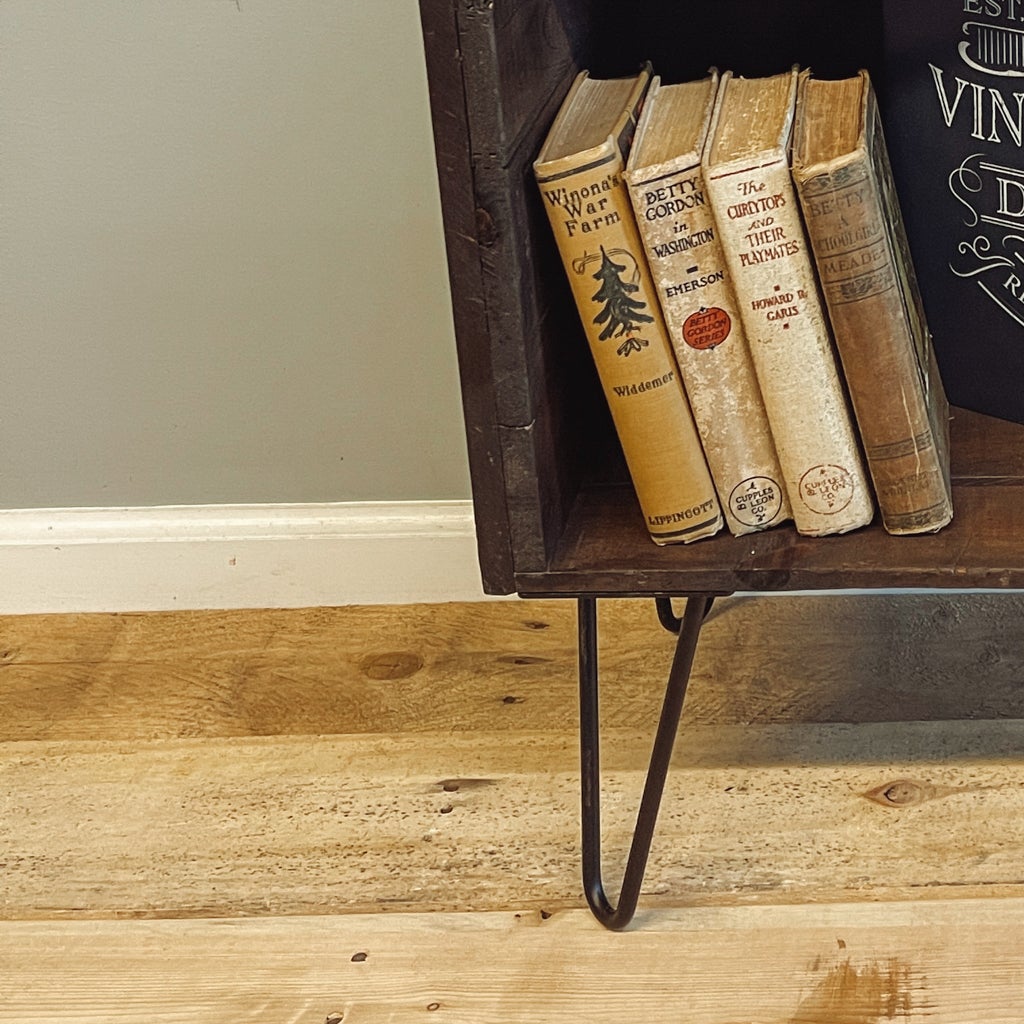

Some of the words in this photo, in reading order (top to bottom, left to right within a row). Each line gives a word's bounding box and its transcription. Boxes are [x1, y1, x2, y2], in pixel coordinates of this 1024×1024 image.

[543, 174, 620, 207] Winona's
[645, 176, 699, 206] BETTY
[737, 179, 767, 196] The
[563, 197, 608, 219] War
[645, 191, 706, 221] GORDON
[727, 193, 787, 220] CURLYTOPS
[564, 211, 621, 238] Farm
[673, 221, 689, 234] in
[747, 216, 775, 231] AND
[652, 228, 715, 258] WASHINGTON
[744, 226, 787, 248] THEIR
[738, 240, 800, 267] PLAYMATES
[665, 270, 725, 298] EMERSON
[751, 292, 795, 311] HOWARD
[687, 317, 728, 337] GORDON
[690, 311, 718, 328] BETTY
[613, 371, 675, 398] Widdemer
[735, 486, 774, 504] CUPPLES
[750, 494, 775, 508] LEON
[648, 499, 715, 526] LIPPINCOTT
